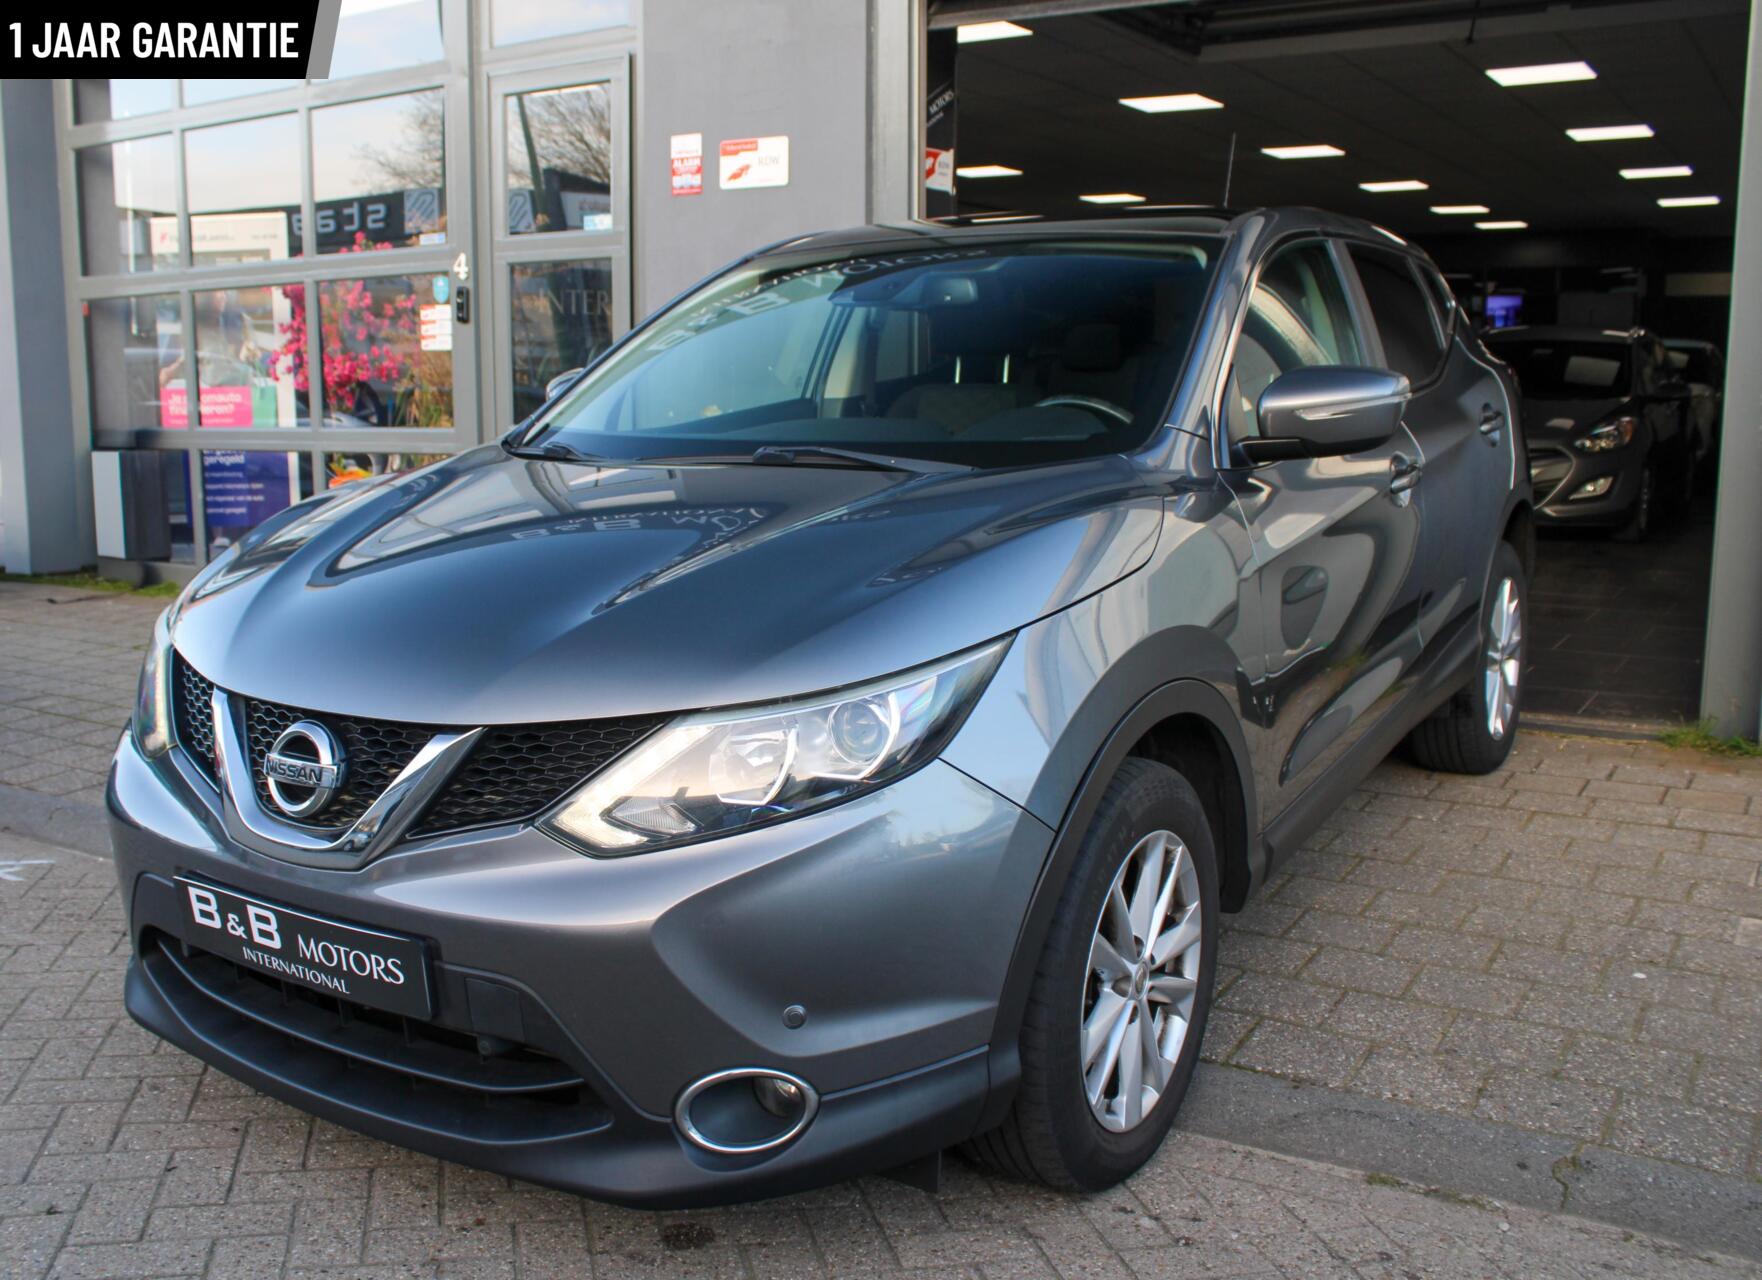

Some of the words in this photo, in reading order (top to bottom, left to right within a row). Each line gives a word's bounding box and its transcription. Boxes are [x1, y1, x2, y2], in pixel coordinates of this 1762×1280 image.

[453, 252, 469, 280] 4
[265, 759, 323, 785] NISSAN
[242, 946, 350, 994] INTERNATIONAL
[297, 933, 405, 985] MOTORS
